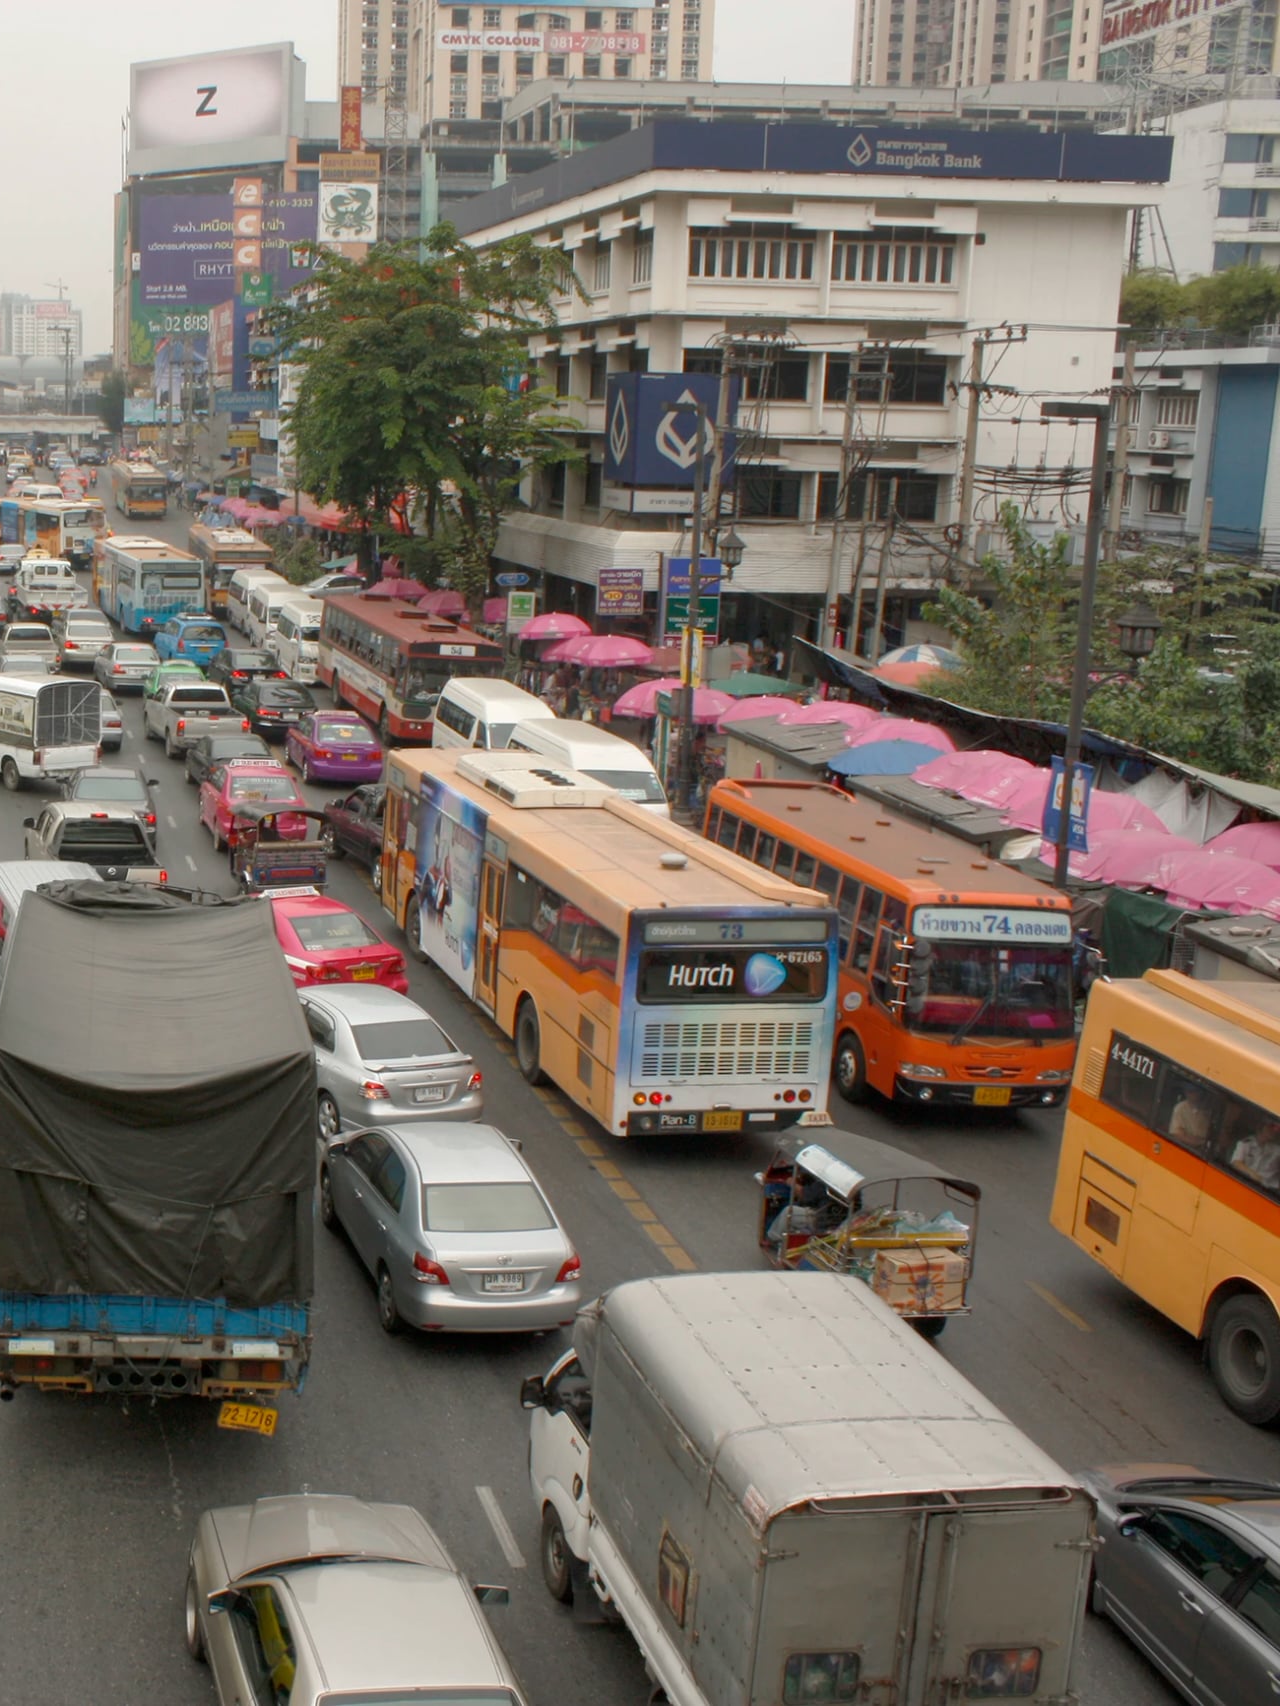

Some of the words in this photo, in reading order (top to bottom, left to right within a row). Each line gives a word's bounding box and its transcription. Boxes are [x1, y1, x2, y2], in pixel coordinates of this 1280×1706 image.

[441, 34, 481, 46] CMYK
[486, 35, 541, 47] COLOUR
[196, 86, 218, 117] Z
[876, 151, 940, 169] Bangkok
[944, 154, 982, 168] Bank
[200, 263, 233, 274] RHYT
[164, 316, 180, 332] 02
[719, 923, 743, 941] 73
[983, 915, 1011, 934] 74
[1111, 1042, 1155, 1079] 4-44171
